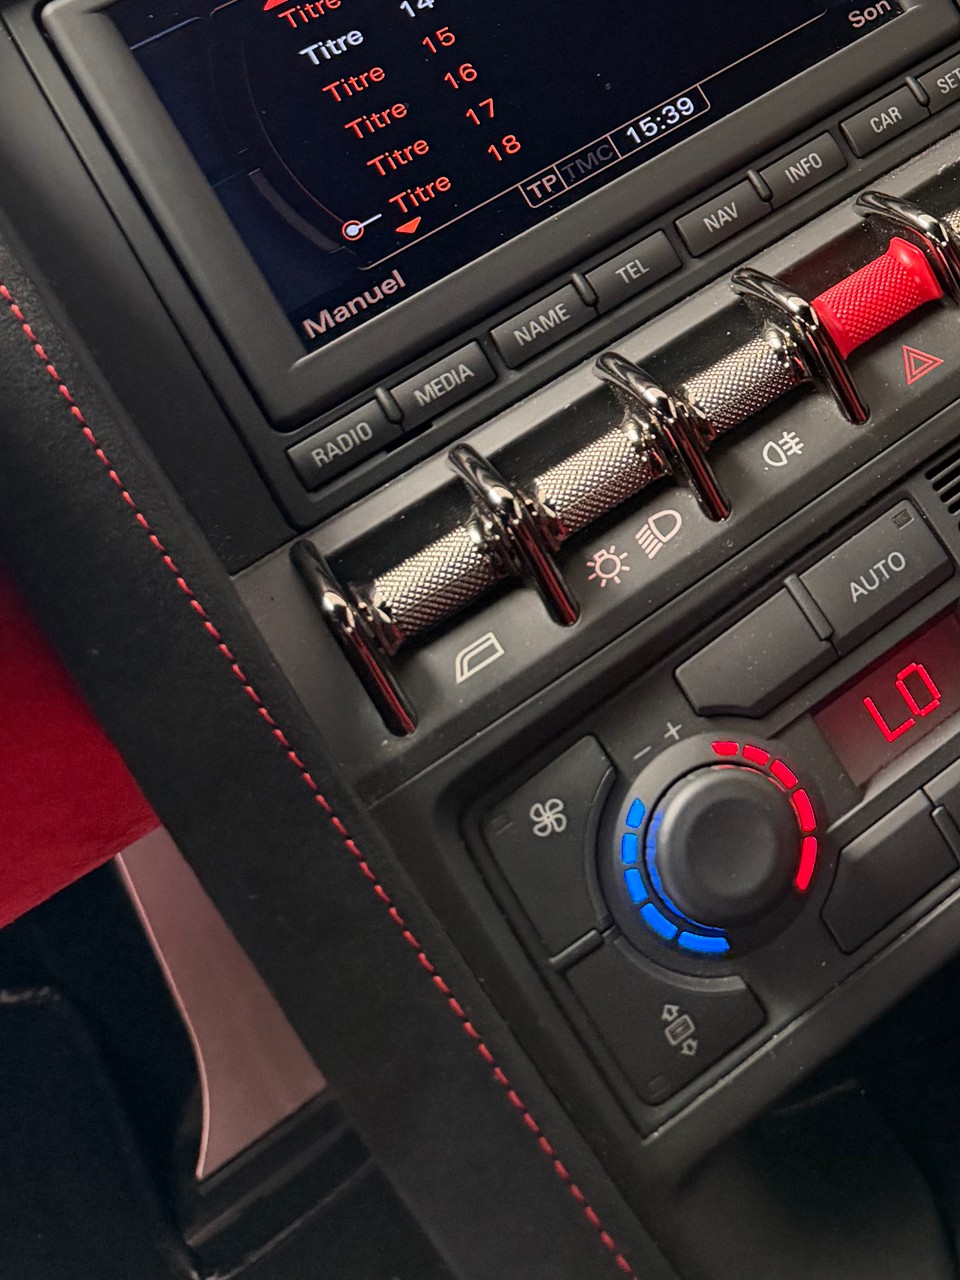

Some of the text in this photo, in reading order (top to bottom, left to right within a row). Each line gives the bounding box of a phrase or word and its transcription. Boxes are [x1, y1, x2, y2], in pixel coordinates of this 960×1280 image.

[847, 0, 892, 29] Son
[299, 30, 364, 65] Titre
[321, 26, 456, 102] Titre 15
[344, 62, 478, 139] Titre 16
[868, 105, 904, 134] CAR
[366, 98, 496, 176] Titre 17
[526, 97, 694, 199] TP TMC 15:39
[388, 134, 522, 213] Titre 18
[784, 151, 824, 185] INFO
[702, 202, 740, 233] NAV
[615, 259, 650, 282] TEL
[302, 271, 406, 339] Manuel
[512, 303, 571, 347] NAME
[413, 363, 475, 407] MEDIA
[310, 423, 373, 467] RADIO
[848, 551, 906, 603] AUTO
[863, 662, 941, 743] LO
